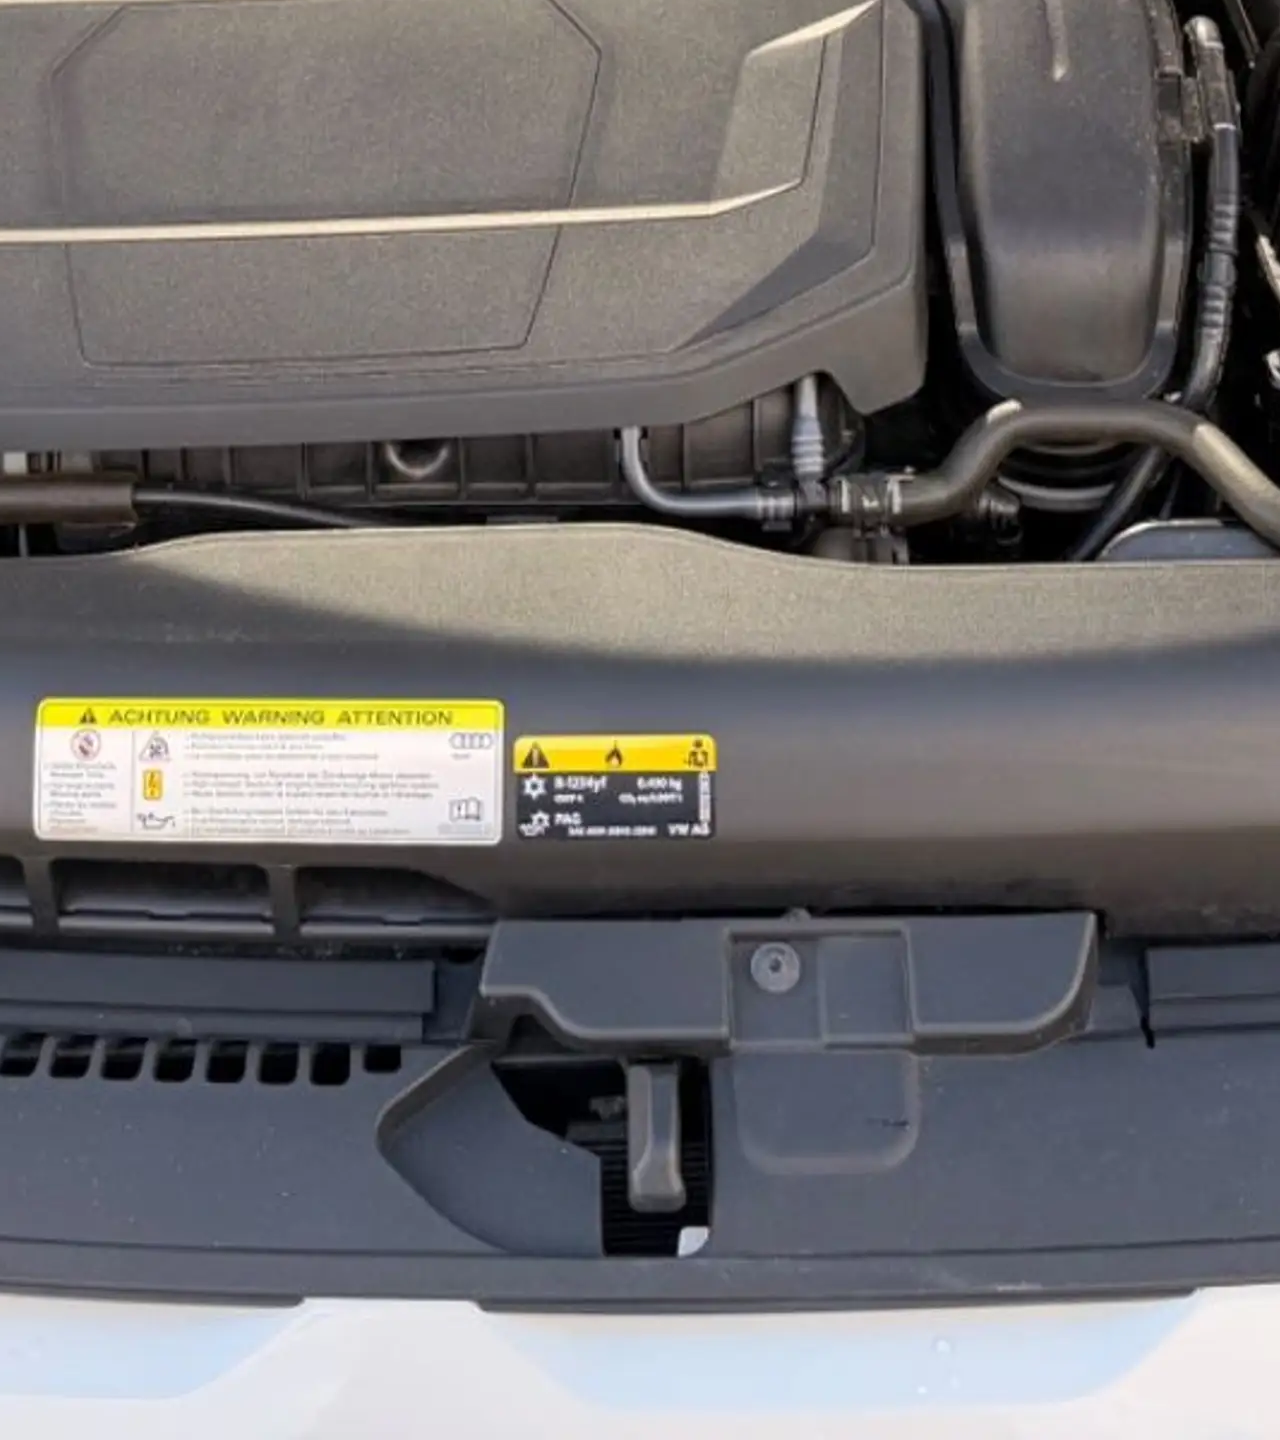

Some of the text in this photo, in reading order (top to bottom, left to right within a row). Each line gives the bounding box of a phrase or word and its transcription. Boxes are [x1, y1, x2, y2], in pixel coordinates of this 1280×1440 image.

[108, 709, 454, 726] ACHTUNG WARNING ATTENTION
[667, 822, 689, 837] VW
[691, 822, 711, 837] AG
